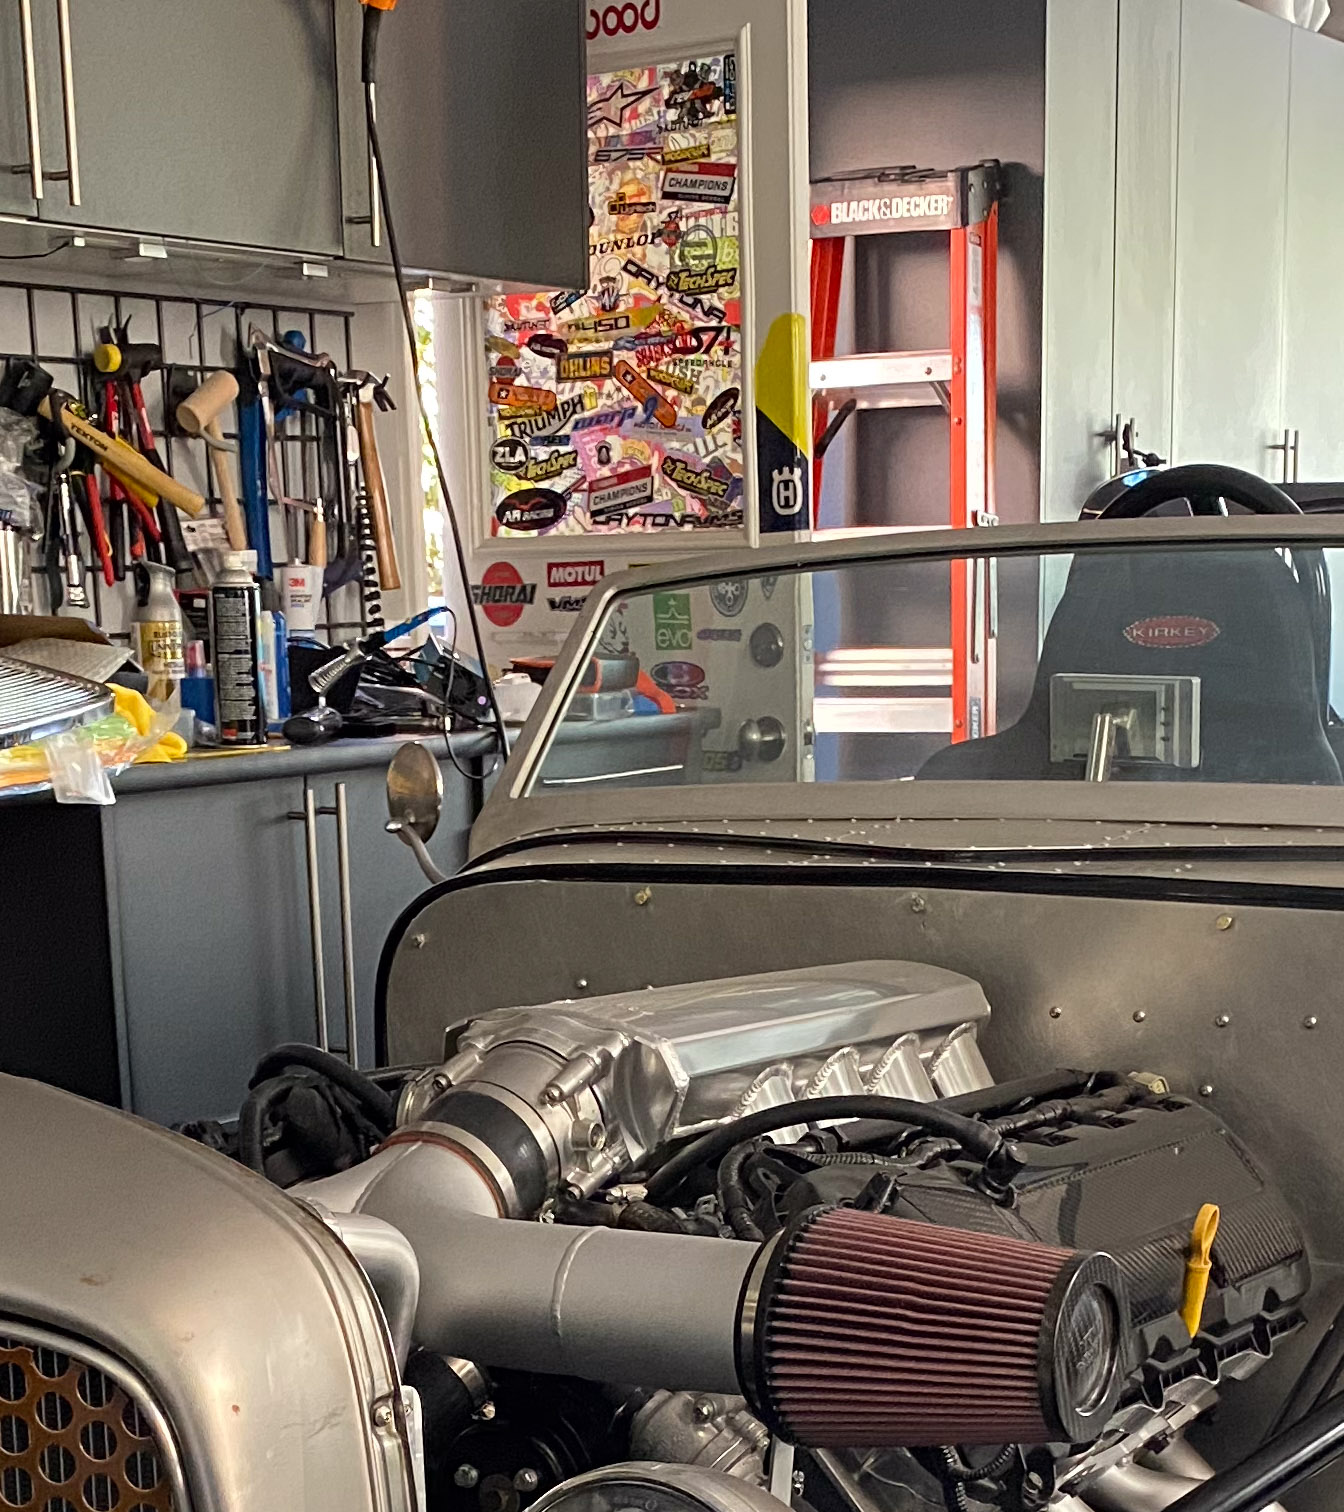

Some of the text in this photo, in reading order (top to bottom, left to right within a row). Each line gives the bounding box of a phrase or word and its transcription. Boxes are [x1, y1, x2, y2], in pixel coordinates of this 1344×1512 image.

[668, 176, 729, 192] CHAMPIONS
[830, 195, 949, 225] BLACK&DECKER
[506, 393, 585, 440] TRIUMPH
[593, 482, 649, 506] CHAMPIONS
[288, 578, 305, 588] 3M
[551, 565, 603, 583] MOTUL
[470, 583, 537, 605] SHORAI
[657, 628, 691, 648] evo
[1132, 625, 1209, 638] KIRKEY
